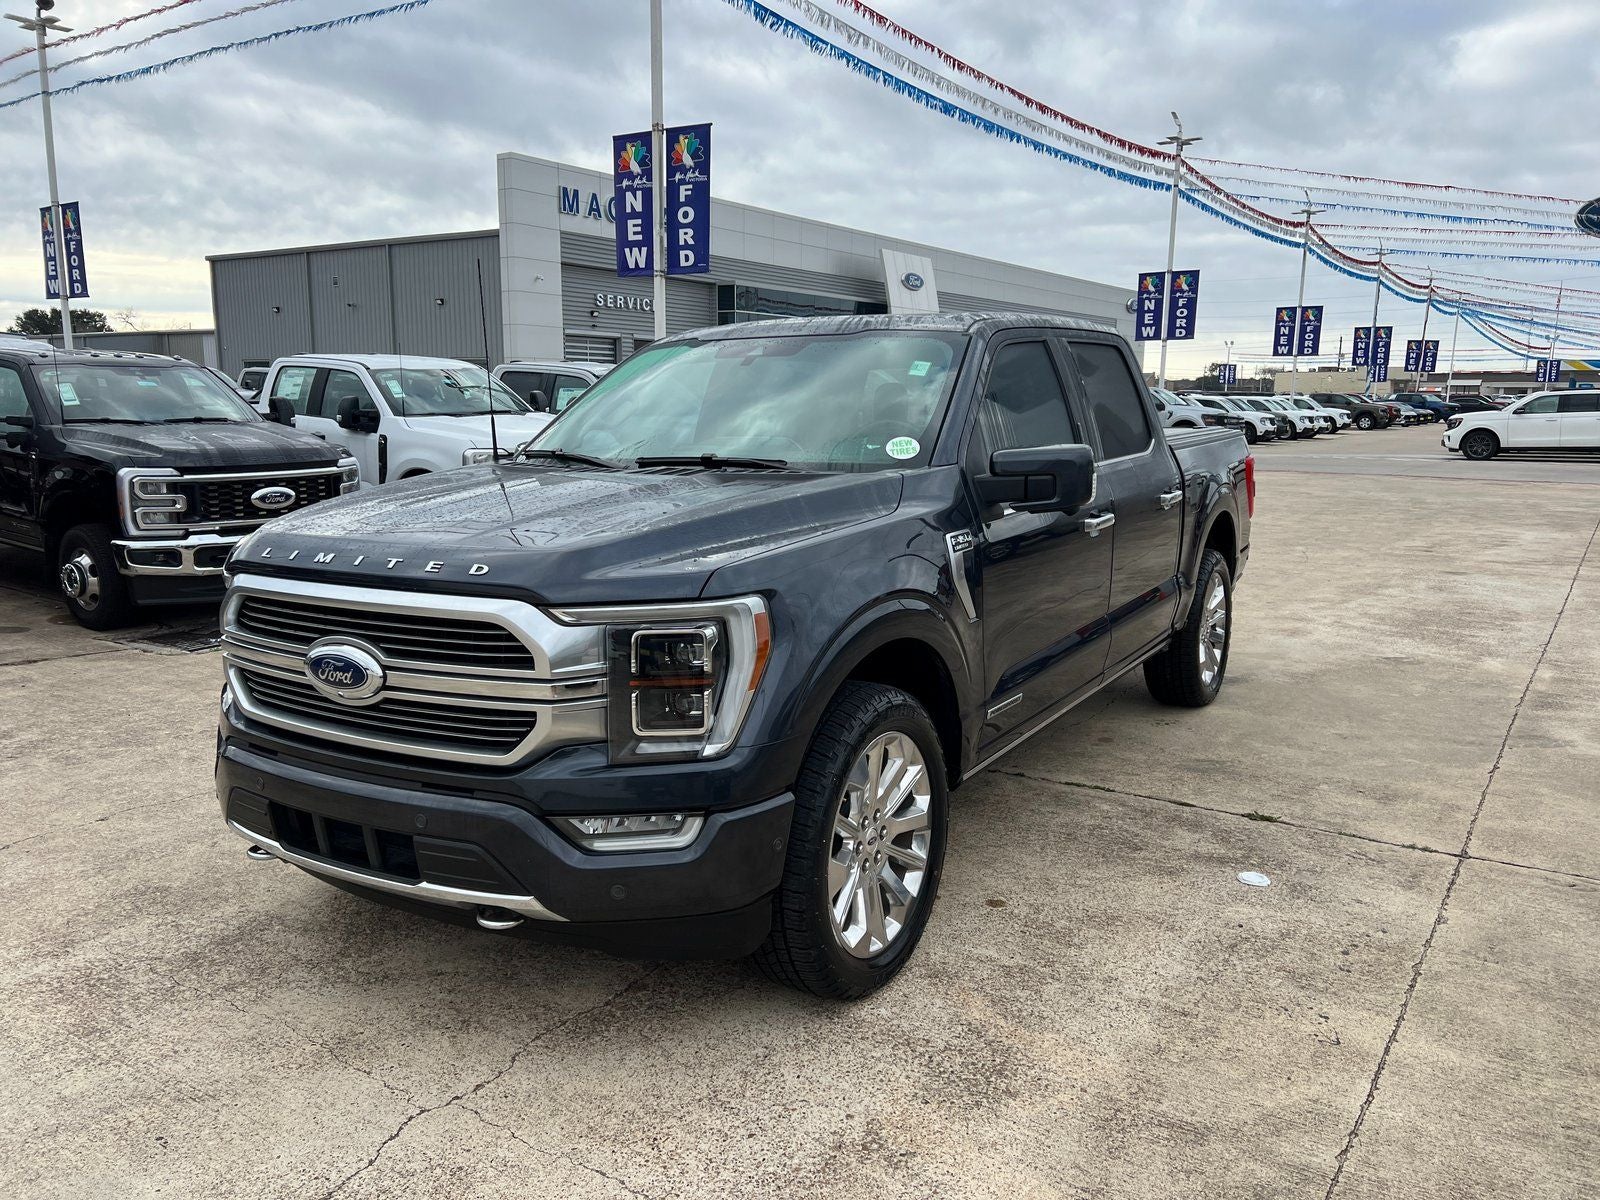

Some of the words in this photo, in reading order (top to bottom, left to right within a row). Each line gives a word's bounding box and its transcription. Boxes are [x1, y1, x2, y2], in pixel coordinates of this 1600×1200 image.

[624, 190, 648, 269] NEW
[677, 184, 695, 267] FORD
[46, 243, 59, 294] NEW
[70, 241, 82, 294] FORD
[596, 293, 655, 312] SERVIC
[1141, 299, 1156, 338] NEW
[1175, 298, 1188, 337] FORD
[1277, 326, 1290, 354] NEW
[1304, 326, 1314, 354] FORD
[1356, 342, 1365, 364] NEW
[1377, 342, 1385, 364] FORD
[1408, 353, 1416, 370] NEW
[1425, 352, 1433, 371] FORD
[889, 447, 918, 456] TIRES
[891, 440, 913, 448] NEW
[265, 493, 286, 503] Ford
[261, 547, 489, 576] LIMITED
[318, 659, 355, 685] Ford
